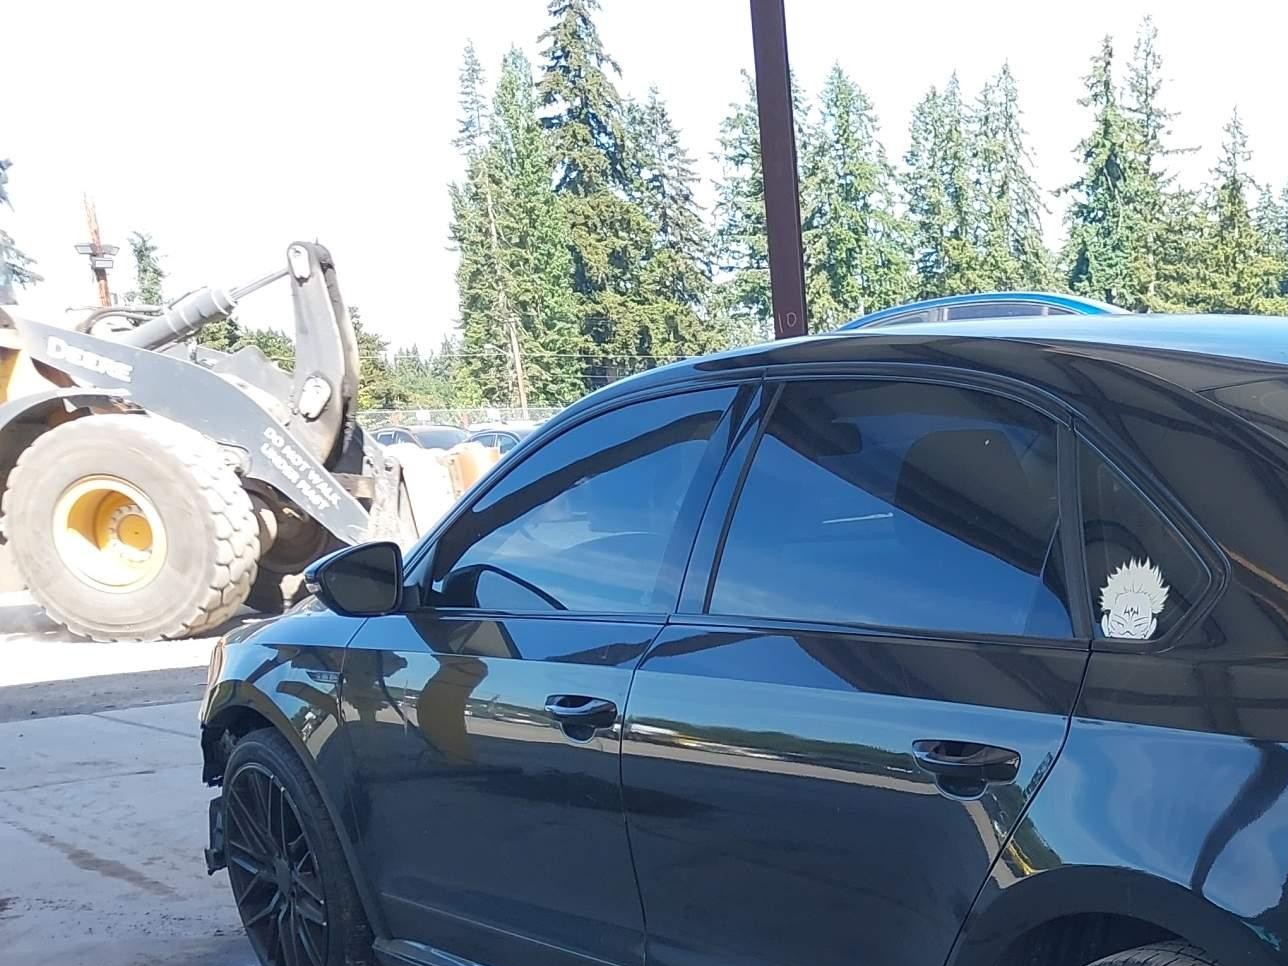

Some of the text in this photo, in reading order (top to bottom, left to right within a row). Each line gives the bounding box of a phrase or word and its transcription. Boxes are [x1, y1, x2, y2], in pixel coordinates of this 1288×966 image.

[260, 442, 300, 484] UNDER
[263, 426, 341, 506] DO NOT WALK
